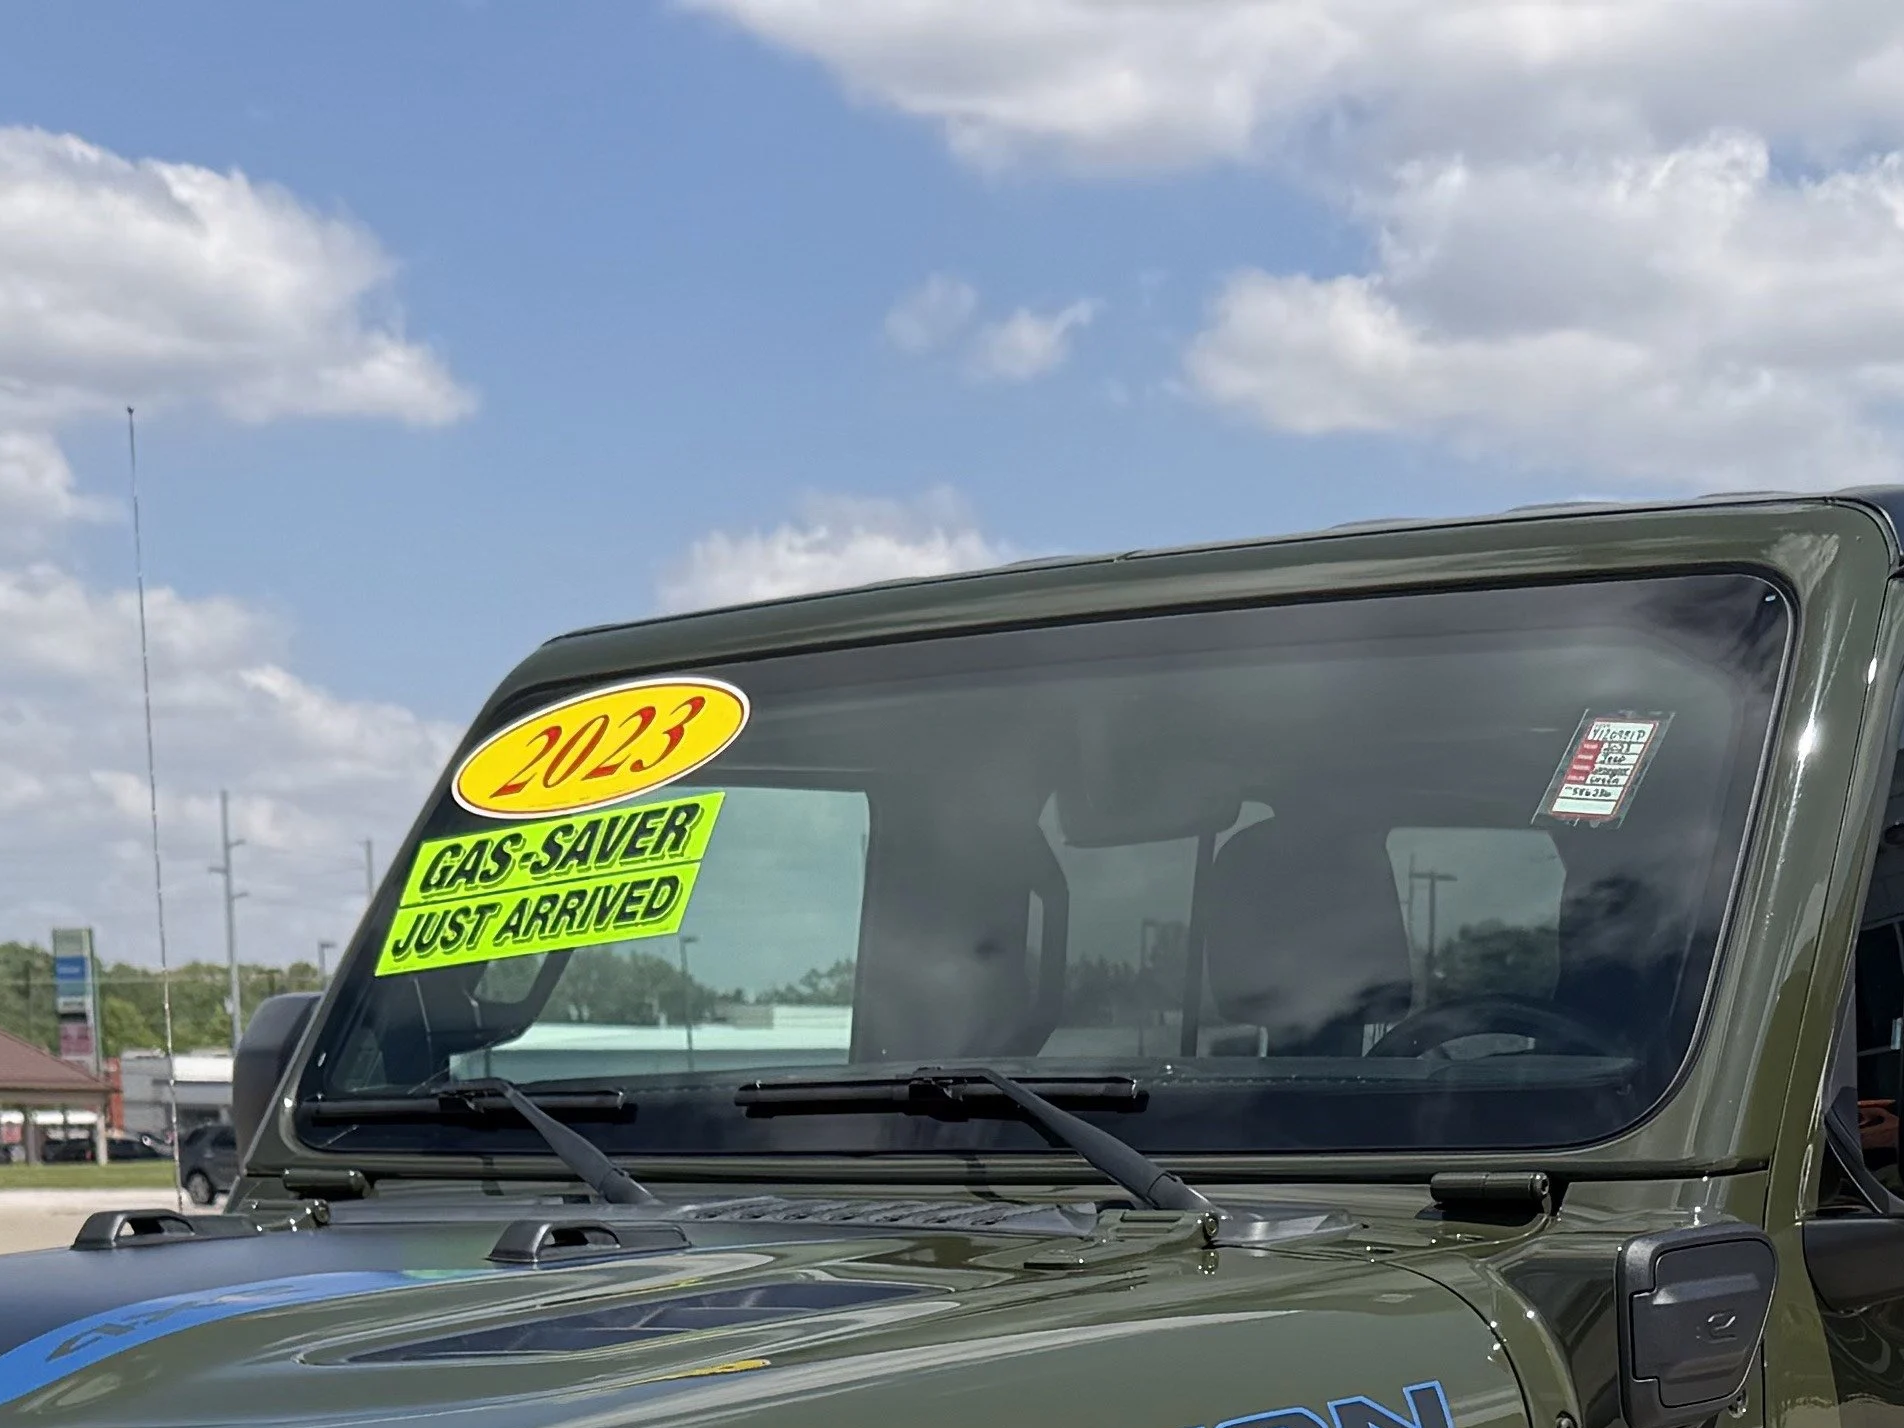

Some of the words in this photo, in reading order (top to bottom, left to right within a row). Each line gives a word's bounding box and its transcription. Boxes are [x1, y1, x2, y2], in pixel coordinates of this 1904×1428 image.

[490, 695, 706, 799] 2023
[419, 802, 704, 900] GAS-SAVER
[391, 900, 502, 962] JUST
[492, 874, 684, 946] ARRIVED
